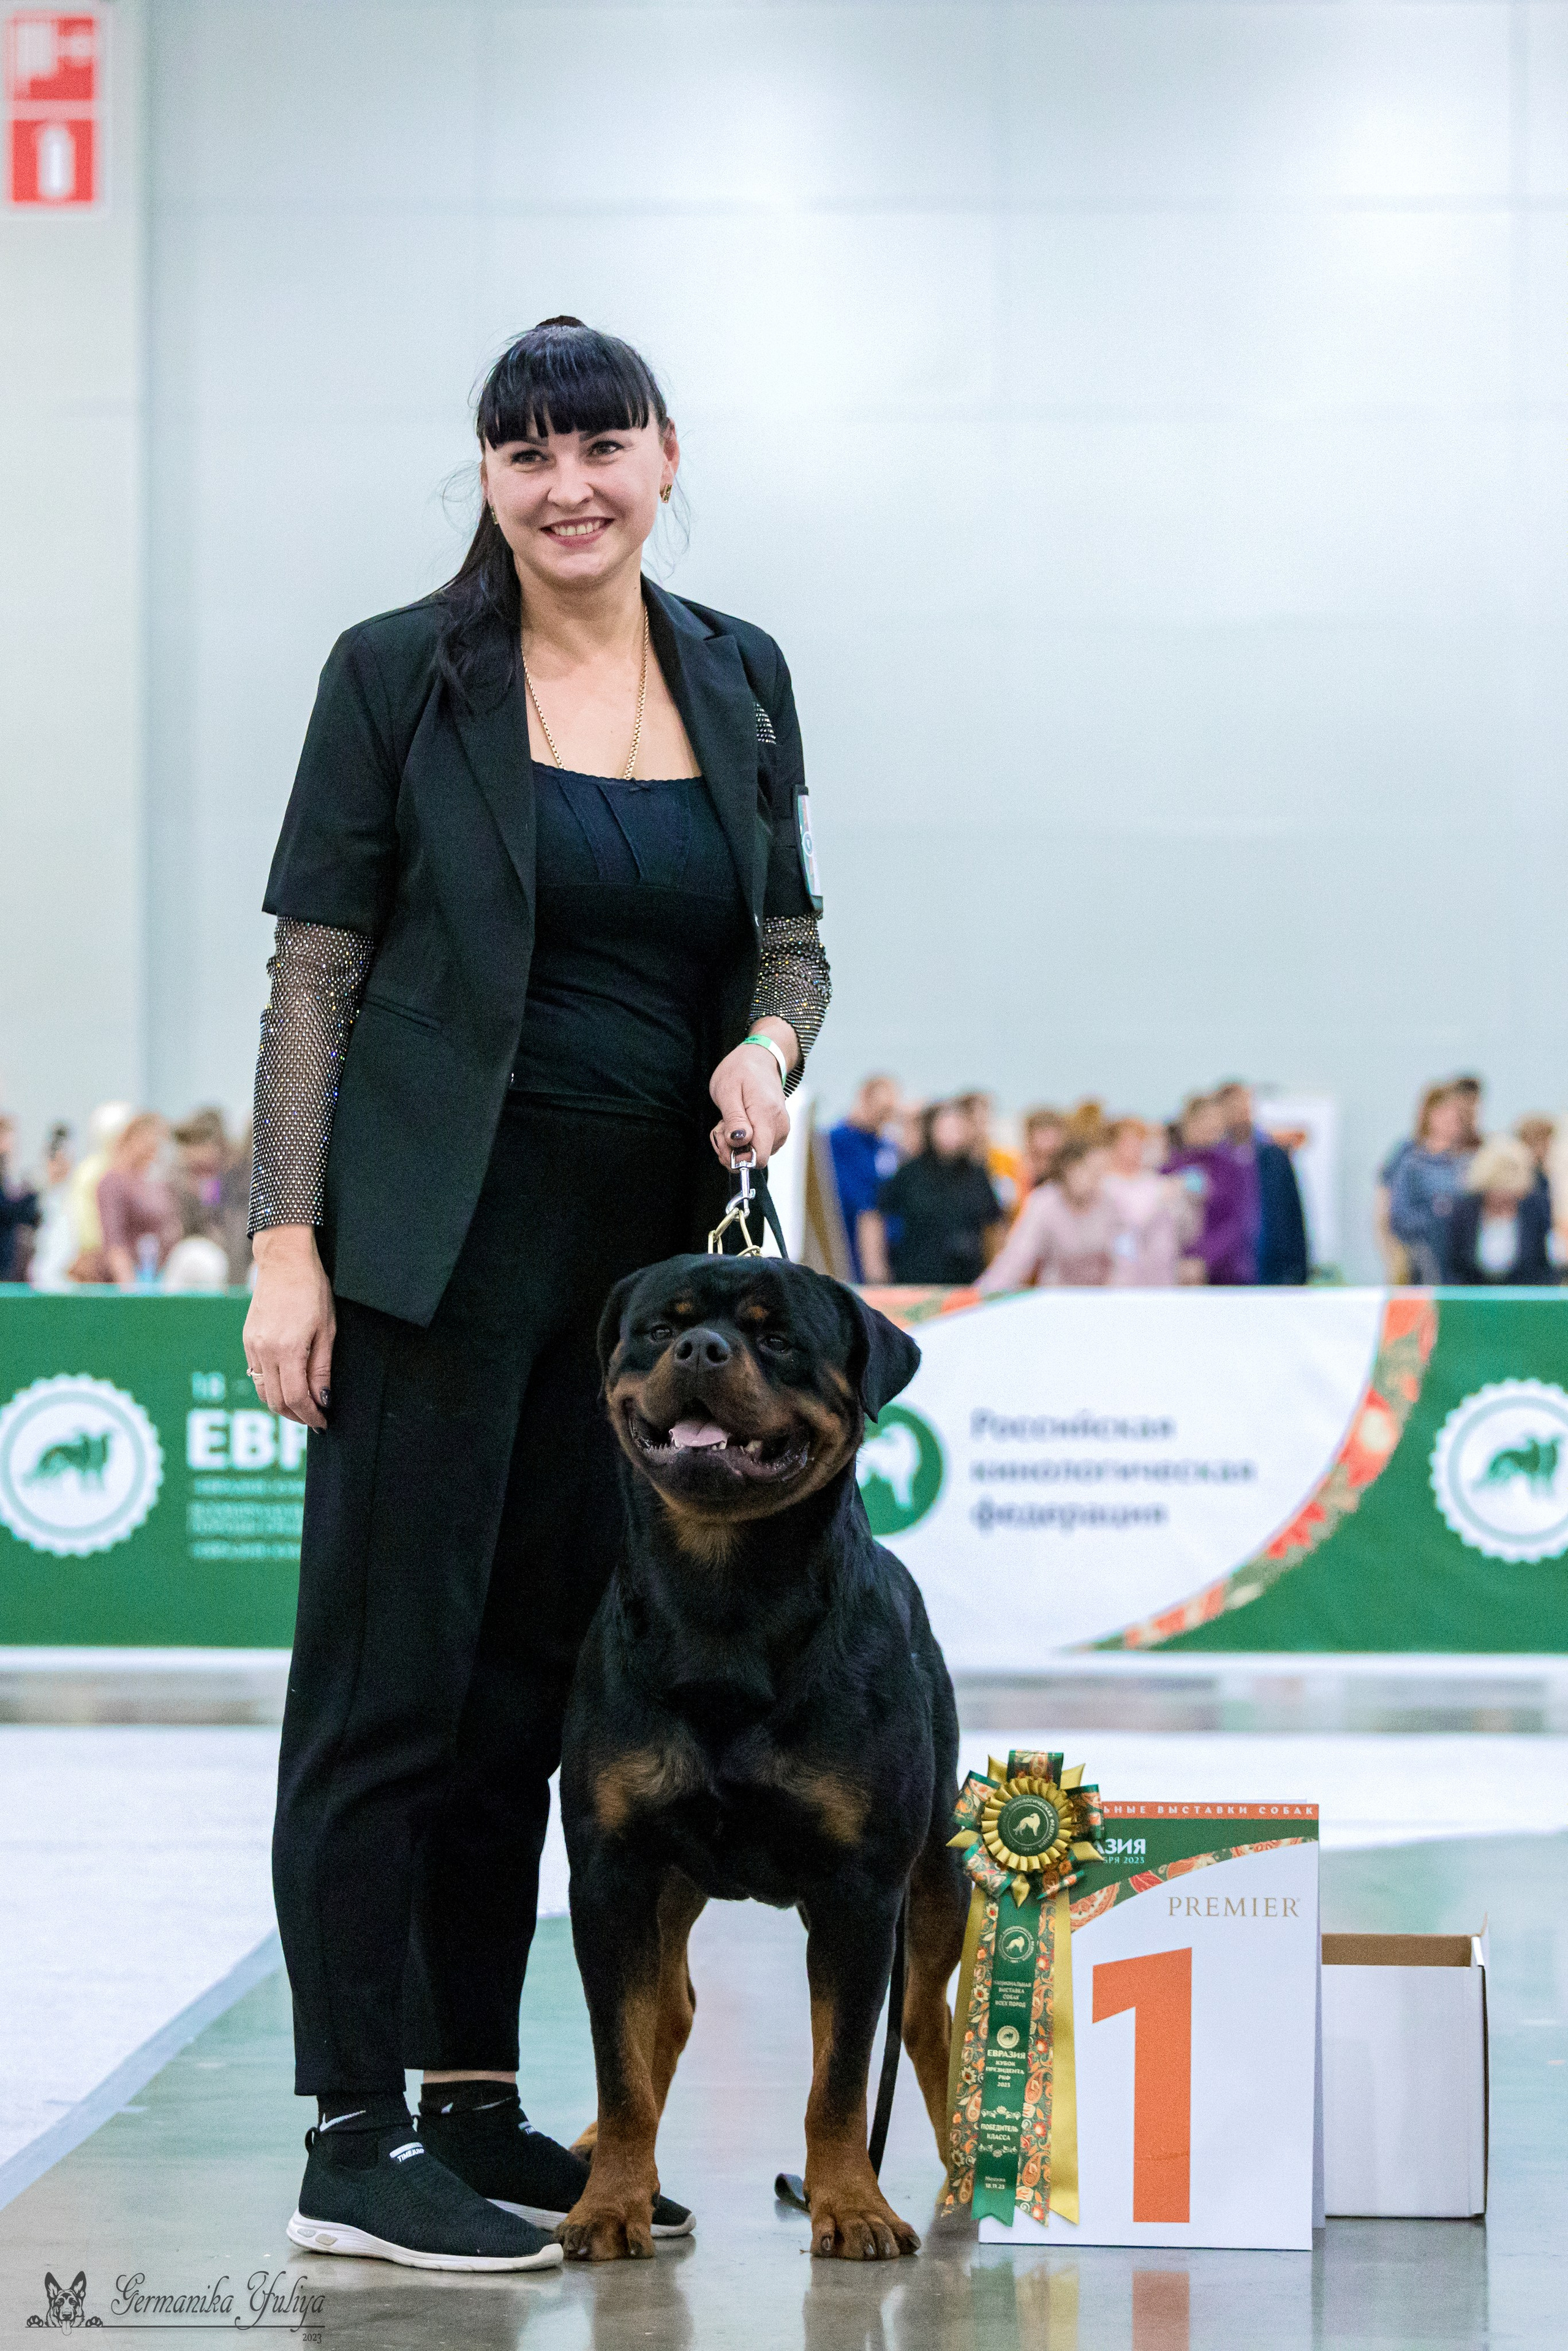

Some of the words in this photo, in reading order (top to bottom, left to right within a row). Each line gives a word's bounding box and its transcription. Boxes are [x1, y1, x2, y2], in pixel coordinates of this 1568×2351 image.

[1157, 1805, 1247, 1815] ВЫСТАВКИ
[1258, 1806, 1313, 1815] СОБАК
[1167, 1896, 1299, 1917] PREMIER
[987, 2049, 1026, 2059] ЕВРАЗИЯ
[986, 2066, 1025, 2075] ПРЕЗИДЕНТА
[1092, 1946, 1193, 2223] 1
[981, 2123, 1019, 2132] ПОБЕДИТЕЛЬ
